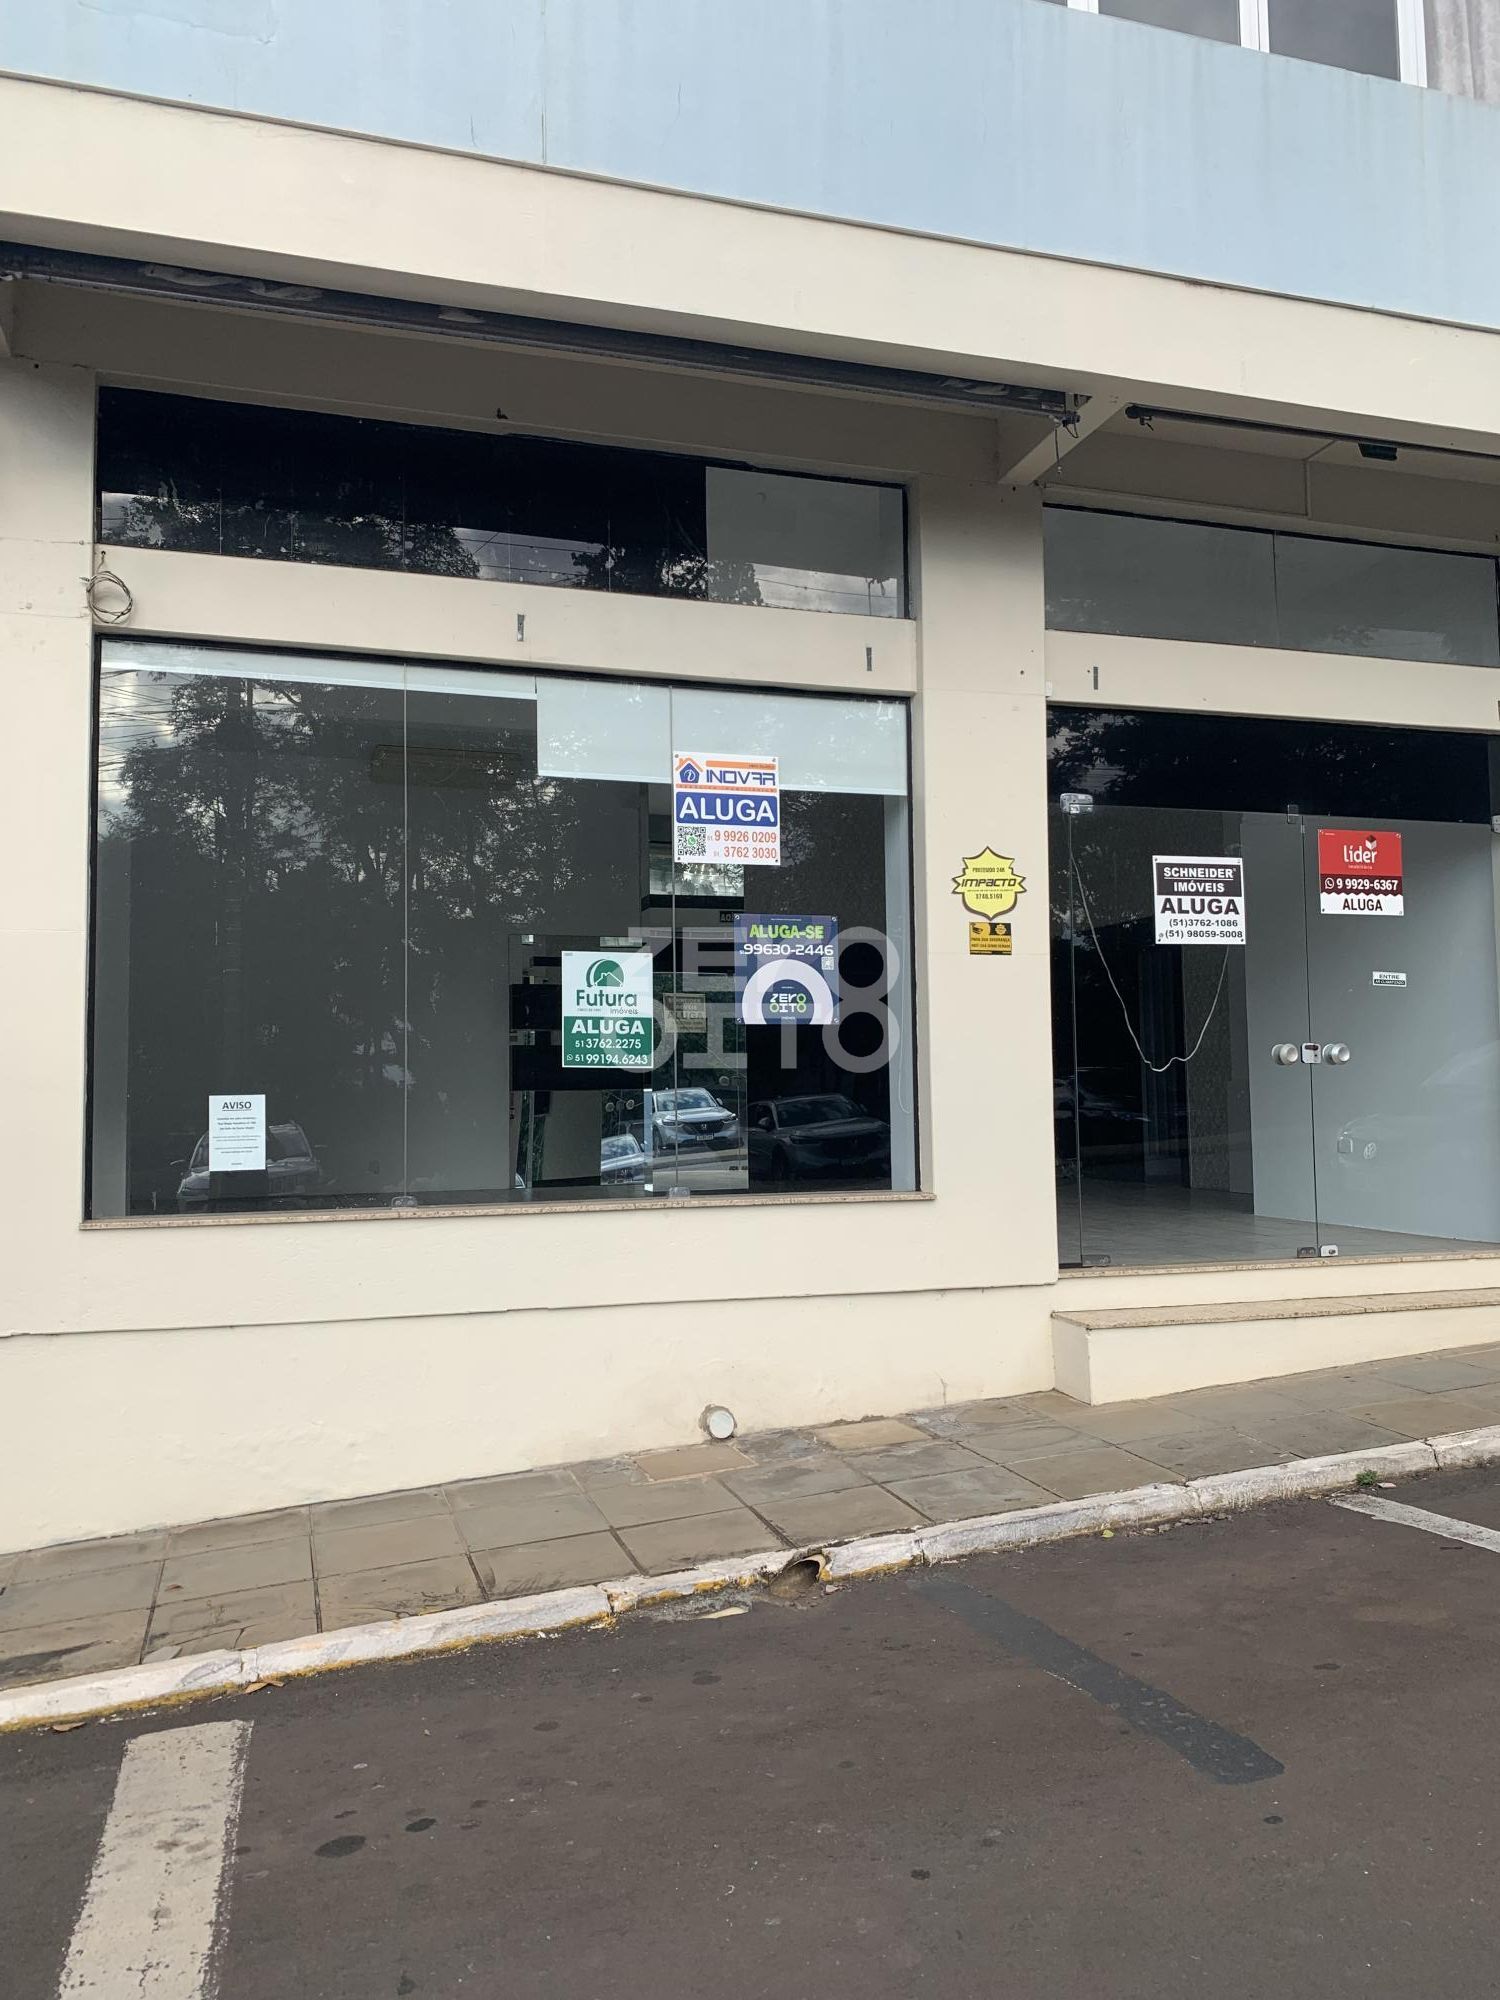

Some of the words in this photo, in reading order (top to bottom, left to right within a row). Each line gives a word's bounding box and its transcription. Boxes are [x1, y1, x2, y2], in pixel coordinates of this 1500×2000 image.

[680, 796, 775, 823] ALUGA
[714, 830, 721, 841] 9
[723, 831, 749, 842] 9926
[751, 832, 777, 843] 0209
[723, 846, 749, 858] 3762
[751, 847, 777, 859] 3030
[1343, 844, 1377, 863] líder
[1163, 867, 1234, 878] SCHNEIDER
[1173, 880, 1225, 893] IMÓVEIS
[1336, 878, 1343, 889] 9
[1345, 878, 1399, 891] 9929-6367
[1160, 897, 1240, 915] ALUGA
[1342, 898, 1383, 912] ALUGA
[1169, 918, 1238, 928] (51)3762-1086
[749, 924, 825, 940] ALUGA-SE
[1165, 930, 1184, 939] (51)
[1186, 930, 1243, 939] 98059-5008
[743, 944, 834, 956] 99630-2446
[576, 989, 638, 1007] Futura
[609, 1006, 639, 1015] imóveis
[571, 1019, 646, 1035] ALUGA
[585, 1039, 642, 1049] 3762.2275
[586, 1054, 648, 1065] 99194.6243
[222, 1101, 252, 1110] AVISO
